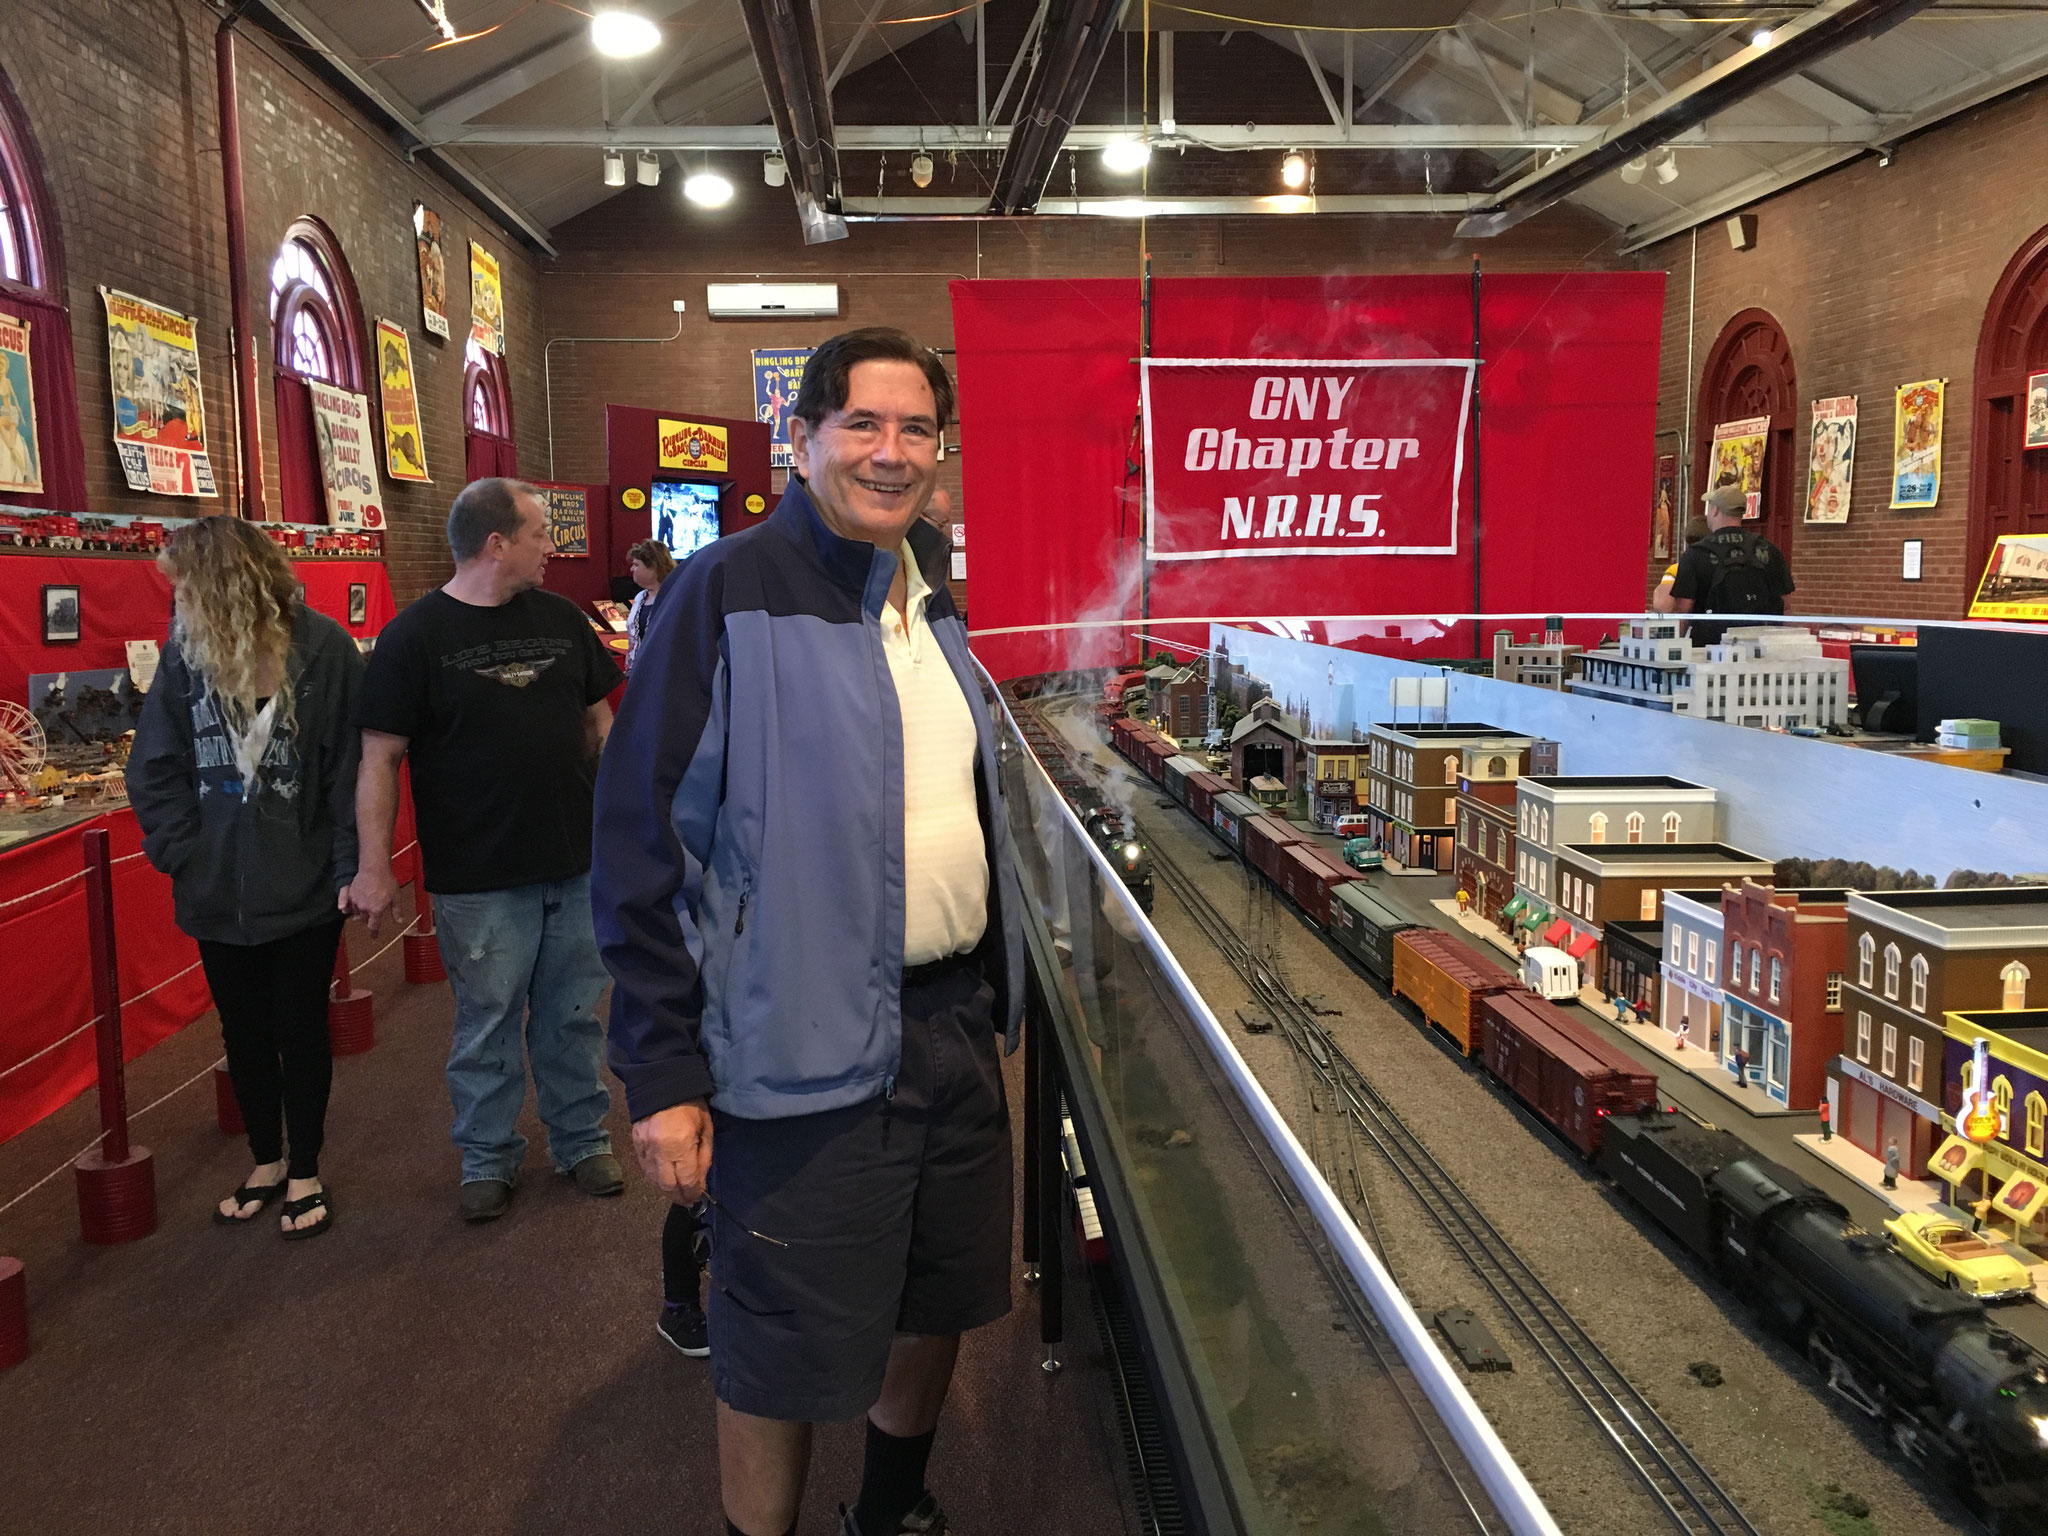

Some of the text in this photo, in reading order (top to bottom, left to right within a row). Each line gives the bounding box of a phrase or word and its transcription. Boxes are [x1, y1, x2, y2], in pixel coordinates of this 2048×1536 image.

[756, 357, 793, 366] RINGLING
[314, 389, 341, 414] INGLING
[1250, 376, 1355, 420] CNY
[682, 459, 708, 468] CIRCUS
[1184, 428, 1420, 477] Chapter
[338, 511, 356, 523] JUNE
[360, 503, 382, 528] 29
[1221, 494, 1386, 540] N.R.H.S.
[554, 524, 586, 547] CIRCUS
[495, 637, 573, 652] BEGINS
[1859, 1071, 1919, 1111] AL'S HARDWARE
